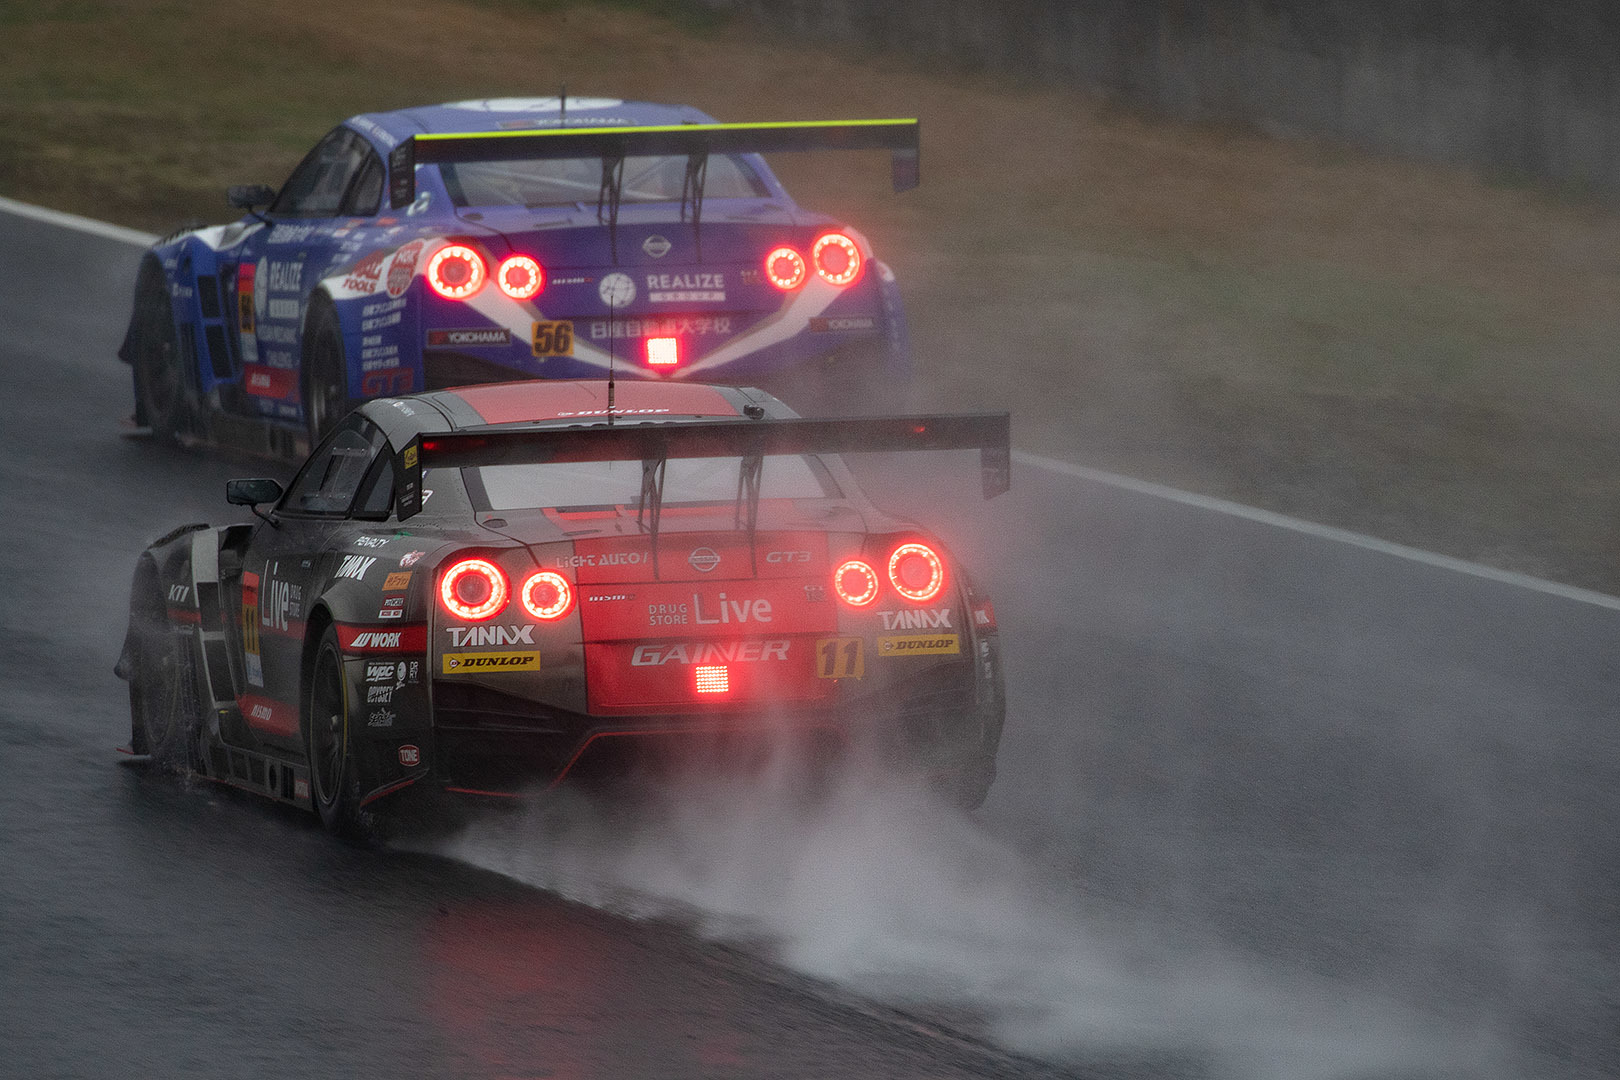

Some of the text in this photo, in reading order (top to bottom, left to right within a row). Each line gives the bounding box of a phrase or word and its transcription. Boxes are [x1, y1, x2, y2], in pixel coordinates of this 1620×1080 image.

[647, 274, 725, 290] REALIZE
[448, 331, 507, 343] YOKOHAMA
[534, 323, 571, 354] 56
[766, 551, 812, 563] GT3
[262, 559, 288, 631] Live
[648, 592, 773, 624] DRUG Live
[649, 614, 688, 625] STORE
[876, 608, 953, 631] TANAX
[370, 632, 402, 648] WORK
[446, 624, 536, 647] TANAX
[631, 639, 791, 667] GAINER
[895, 640, 954, 650] DUNLOP
[462, 657, 535, 667] DUNLOP
[822, 641, 858, 676] 11
[400, 749, 418, 763] TONE
